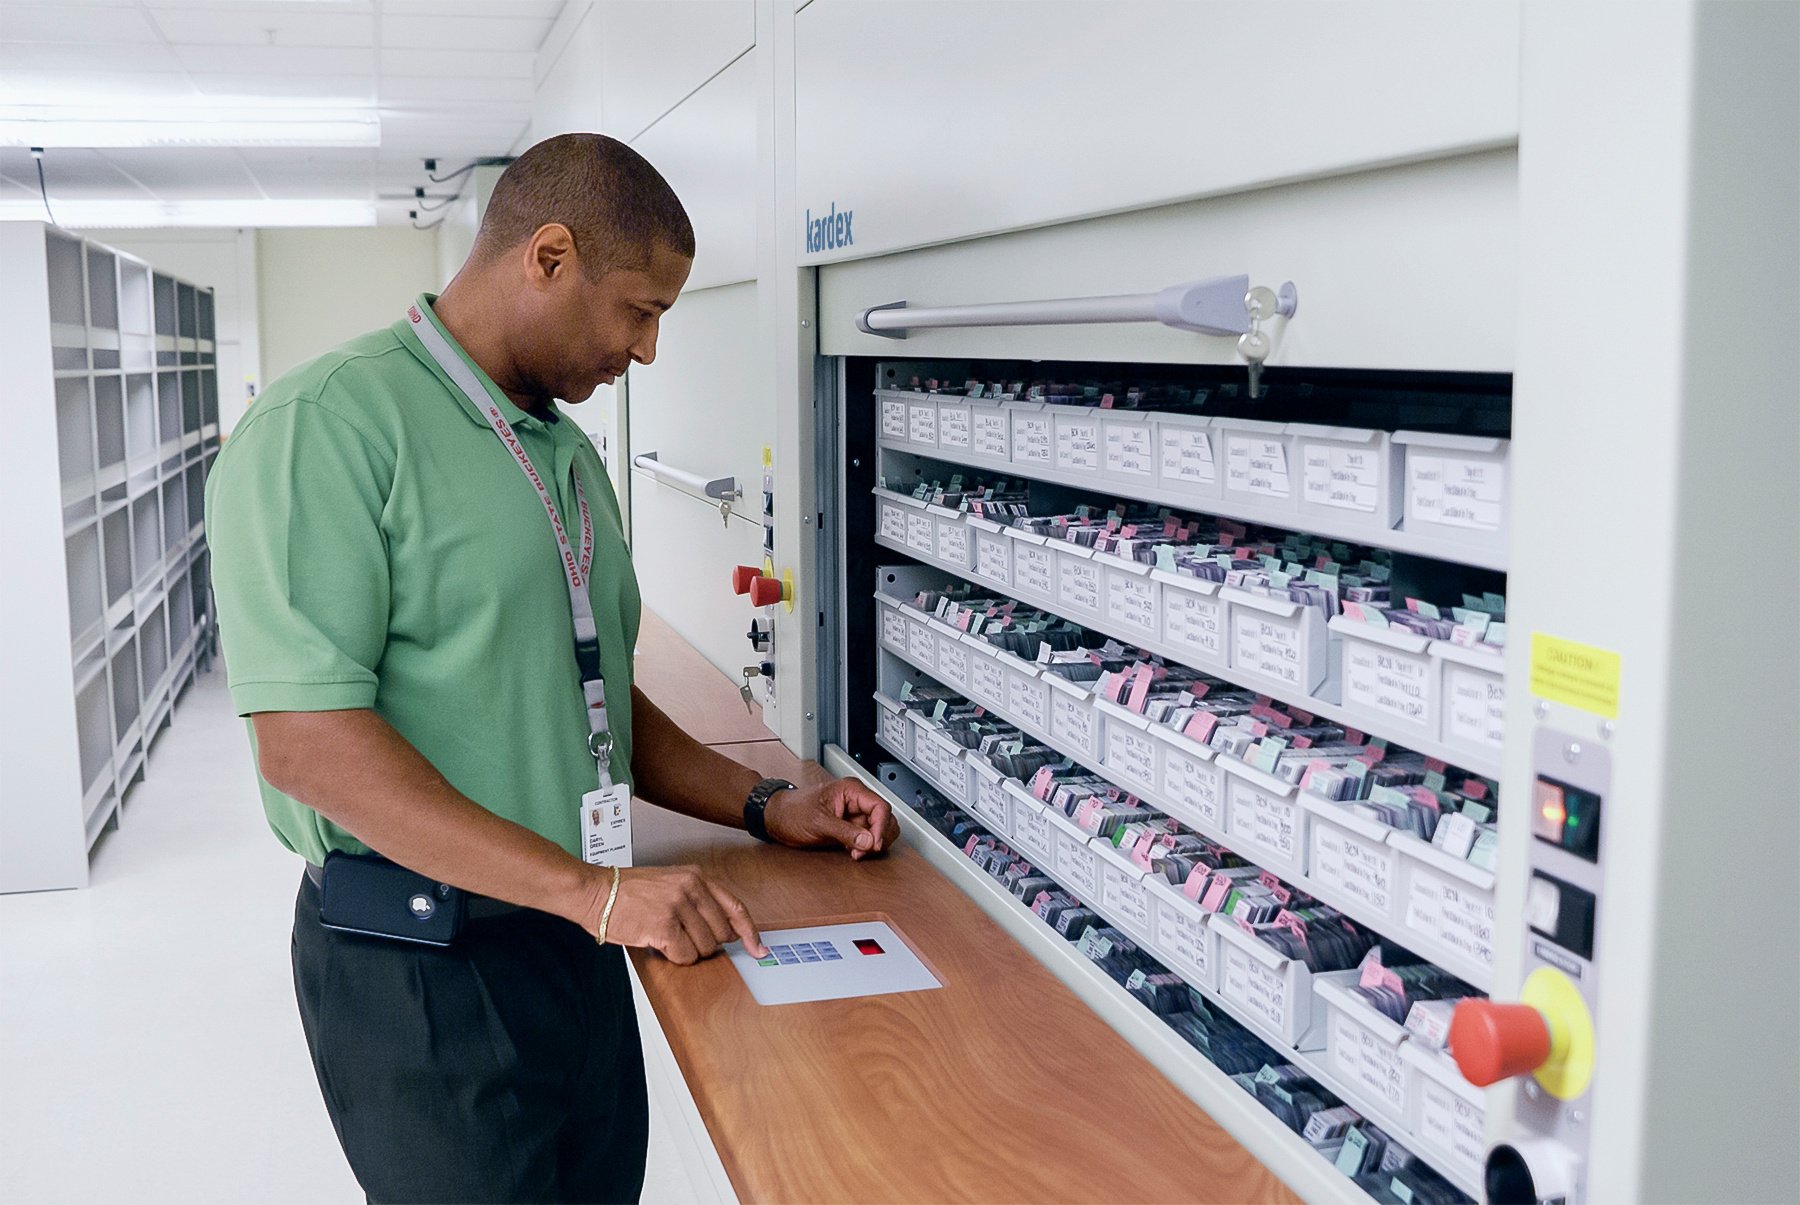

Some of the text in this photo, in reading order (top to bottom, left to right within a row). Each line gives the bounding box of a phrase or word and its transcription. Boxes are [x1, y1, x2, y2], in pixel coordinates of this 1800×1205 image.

[806, 201, 854, 253] kardex
[544, 495, 568, 545] STATE
[565, 551, 582, 588] OHIO
[1546, 646, 1594, 671] CAUTION
